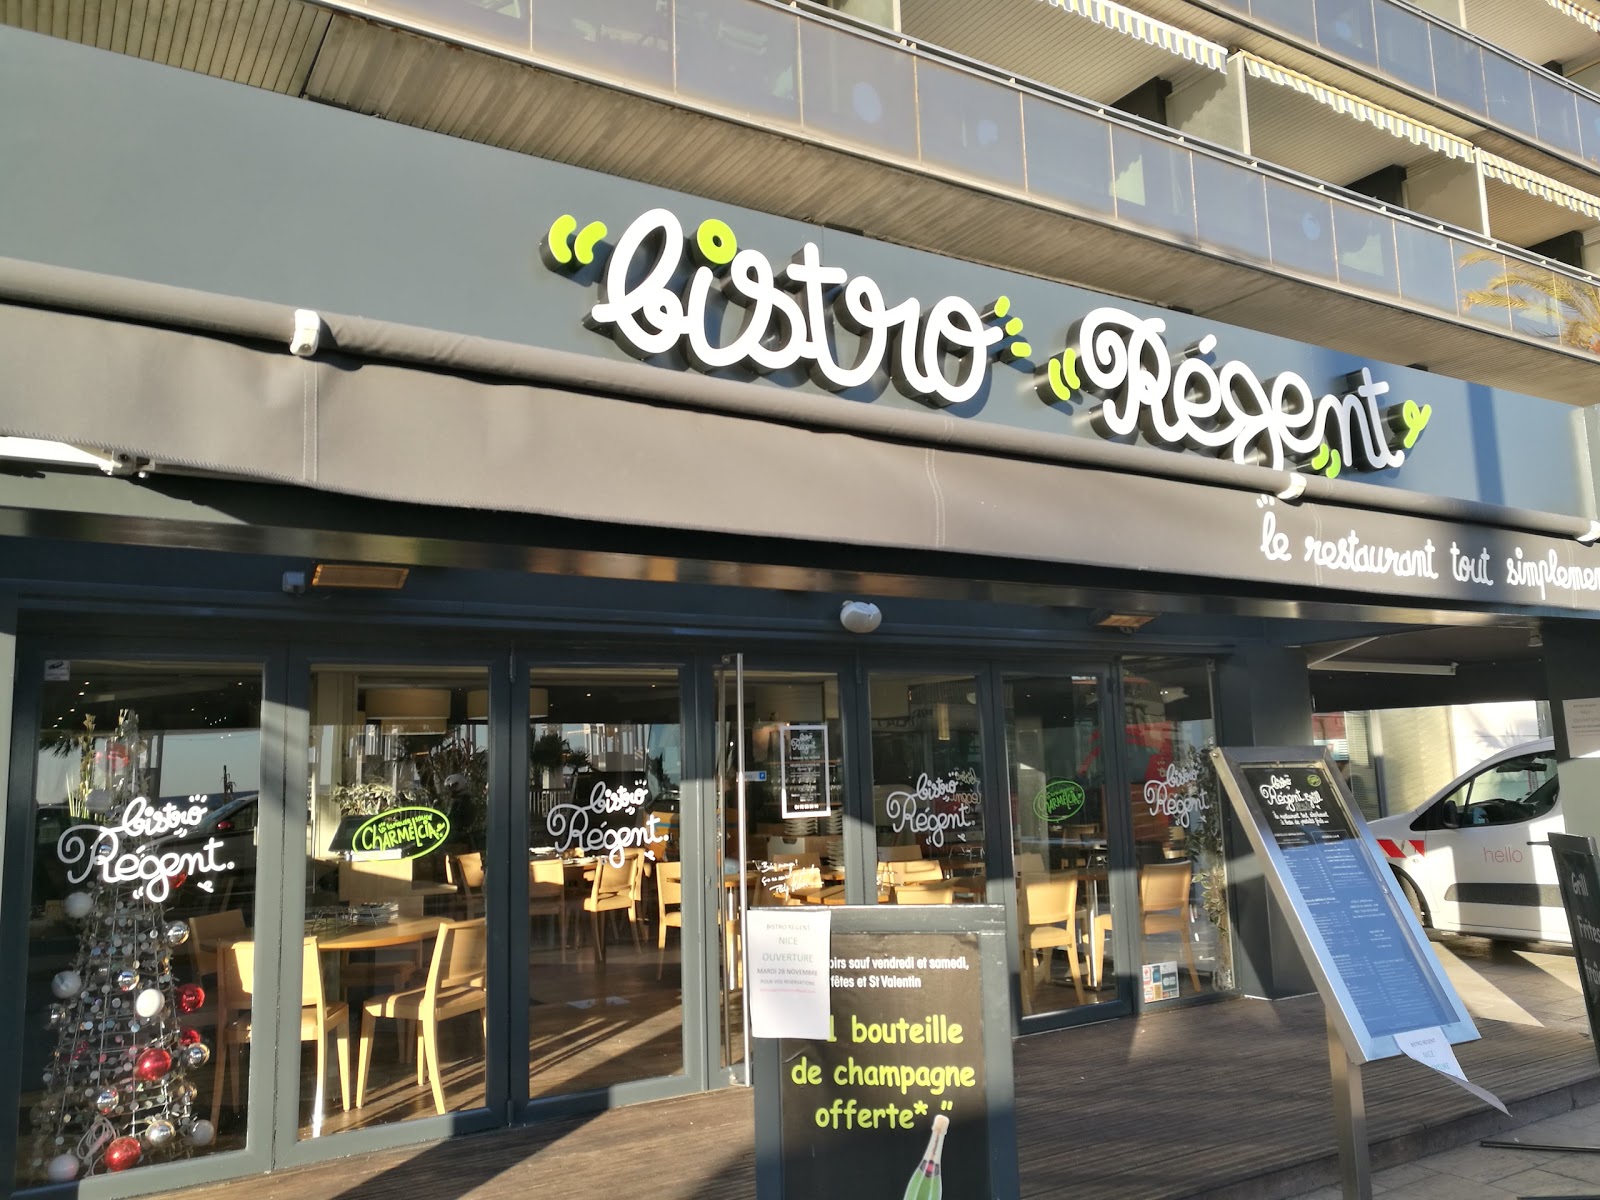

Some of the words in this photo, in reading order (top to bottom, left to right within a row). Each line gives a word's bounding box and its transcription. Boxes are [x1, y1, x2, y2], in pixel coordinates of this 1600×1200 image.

[591, 207, 1004, 404] bistro
[1078, 306, 1406, 471] Régent
[1260, 510, 1293, 562] le
[1304, 529, 1440, 580] restaurant
[1450, 541, 1494, 586] tout
[1482, 846, 1523, 863] hello
[1571, 871, 1589, 897] Grill
[778, 936, 799, 945] NICE
[762, 952, 814, 962] OUVERTURE
[848, 957, 870, 970] sauf
[872, 957, 915, 970] vendredi
[916, 958, 927, 970] et
[929, 956, 970, 971] samedi,
[756, 967, 777, 975] MARDI
[786, 968, 818, 976] NOVEMBRE
[830, 975, 855, 988] fêtes
[857, 976, 867, 988] et
[880, 975, 922, 989] Valentin
[851, 1014, 964, 1044] bouteille
[791, 1056, 823, 1085] de
[833, 1056, 976, 1095] champagne
